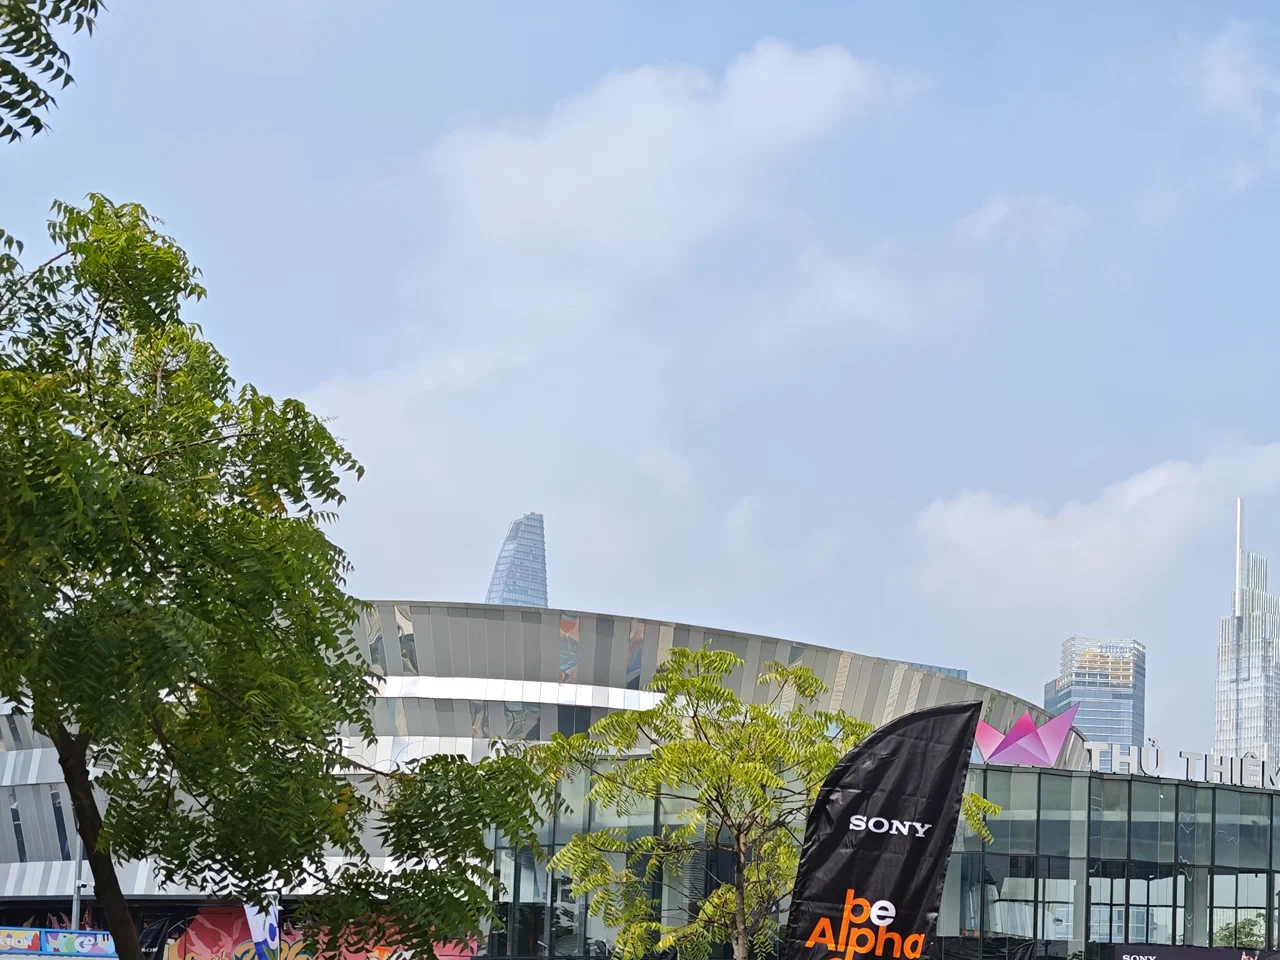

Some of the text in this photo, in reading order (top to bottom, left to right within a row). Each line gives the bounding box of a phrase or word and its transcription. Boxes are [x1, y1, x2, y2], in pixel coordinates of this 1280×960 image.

[849, 815, 932, 837] SONY
[844, 888, 896, 927] be
[805, 917, 925, 960] Alpha
